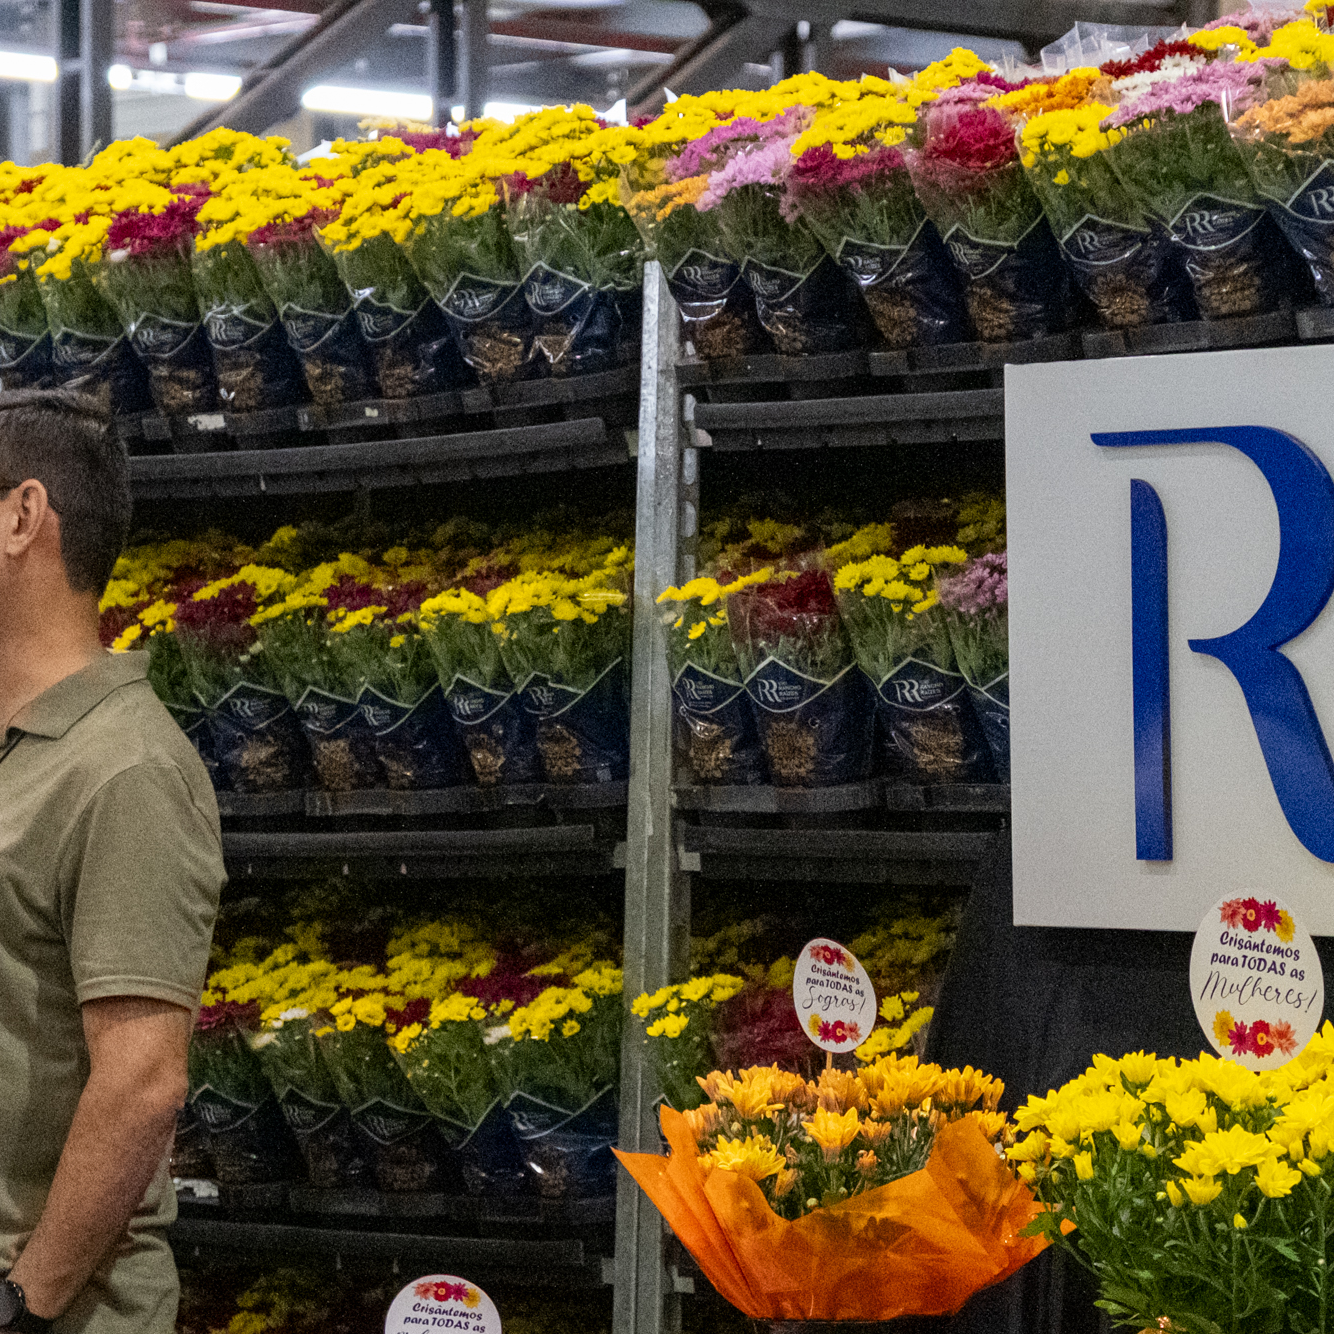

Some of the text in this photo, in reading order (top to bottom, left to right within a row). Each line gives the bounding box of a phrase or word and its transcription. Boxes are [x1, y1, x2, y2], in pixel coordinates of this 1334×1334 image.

[1183, 210, 1216, 237] RR
[757, 679, 782, 702] RR
[892, 679, 924, 702] RR
[1220, 931, 1300, 961] Crisântemos
[811, 964, 860, 985] Crisântemos
[1211, 953, 1305, 981] para TODAS as
[806, 977, 865, 998] para TODAS as
[1200, 970, 1317, 1013] Mulheres!
[802, 985, 867, 1015] Sogras!
[412, 1302, 483, 1321] Crisântemos
[404, 1316, 486, 1334] para TODAS as
